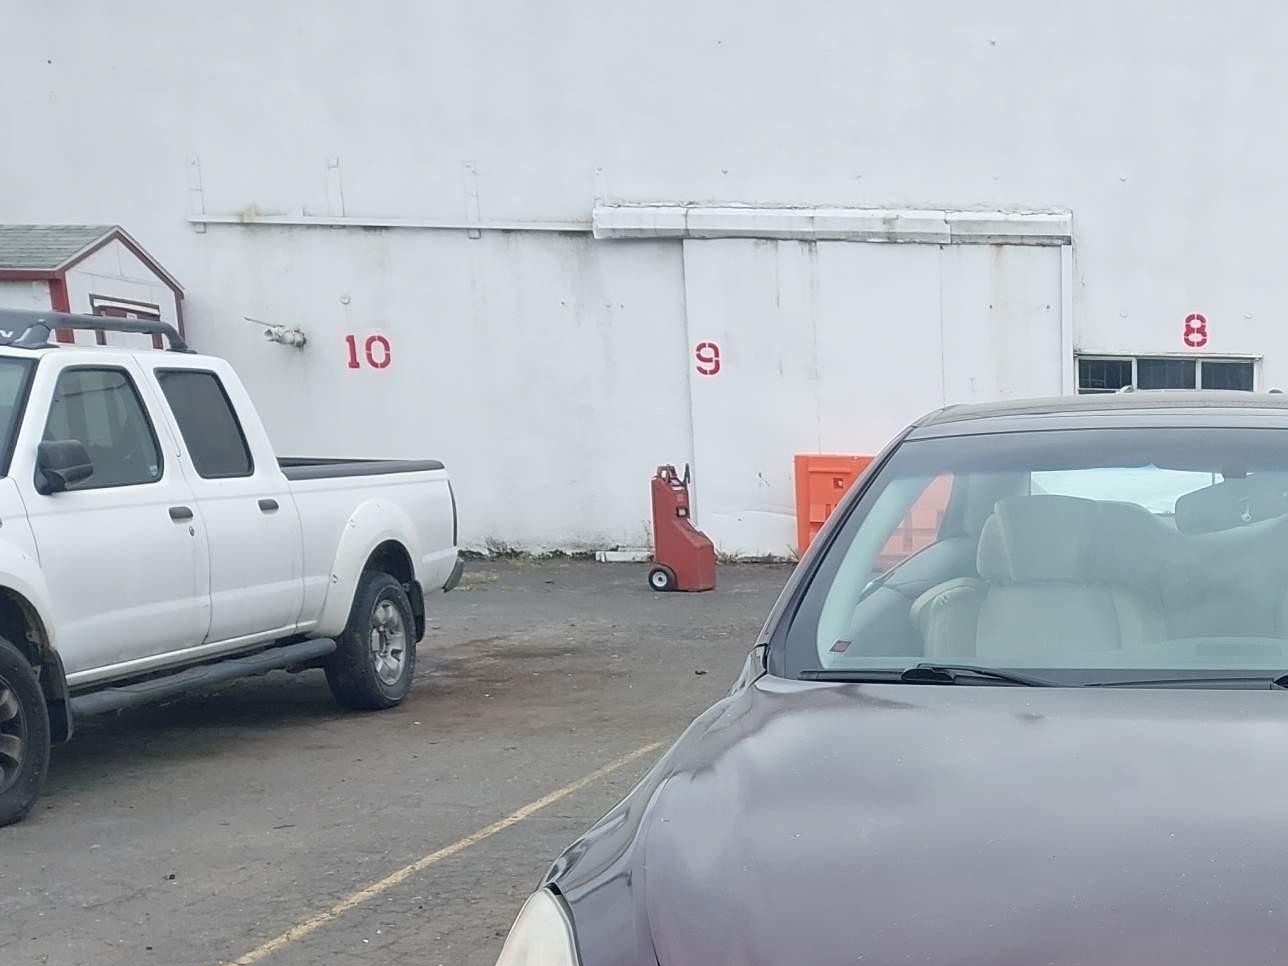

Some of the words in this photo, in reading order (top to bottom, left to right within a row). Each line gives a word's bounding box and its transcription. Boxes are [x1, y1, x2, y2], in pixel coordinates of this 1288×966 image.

[1183, 314, 1208, 348] 8
[346, 335, 391, 369] 10
[696, 342, 721, 376] 9
